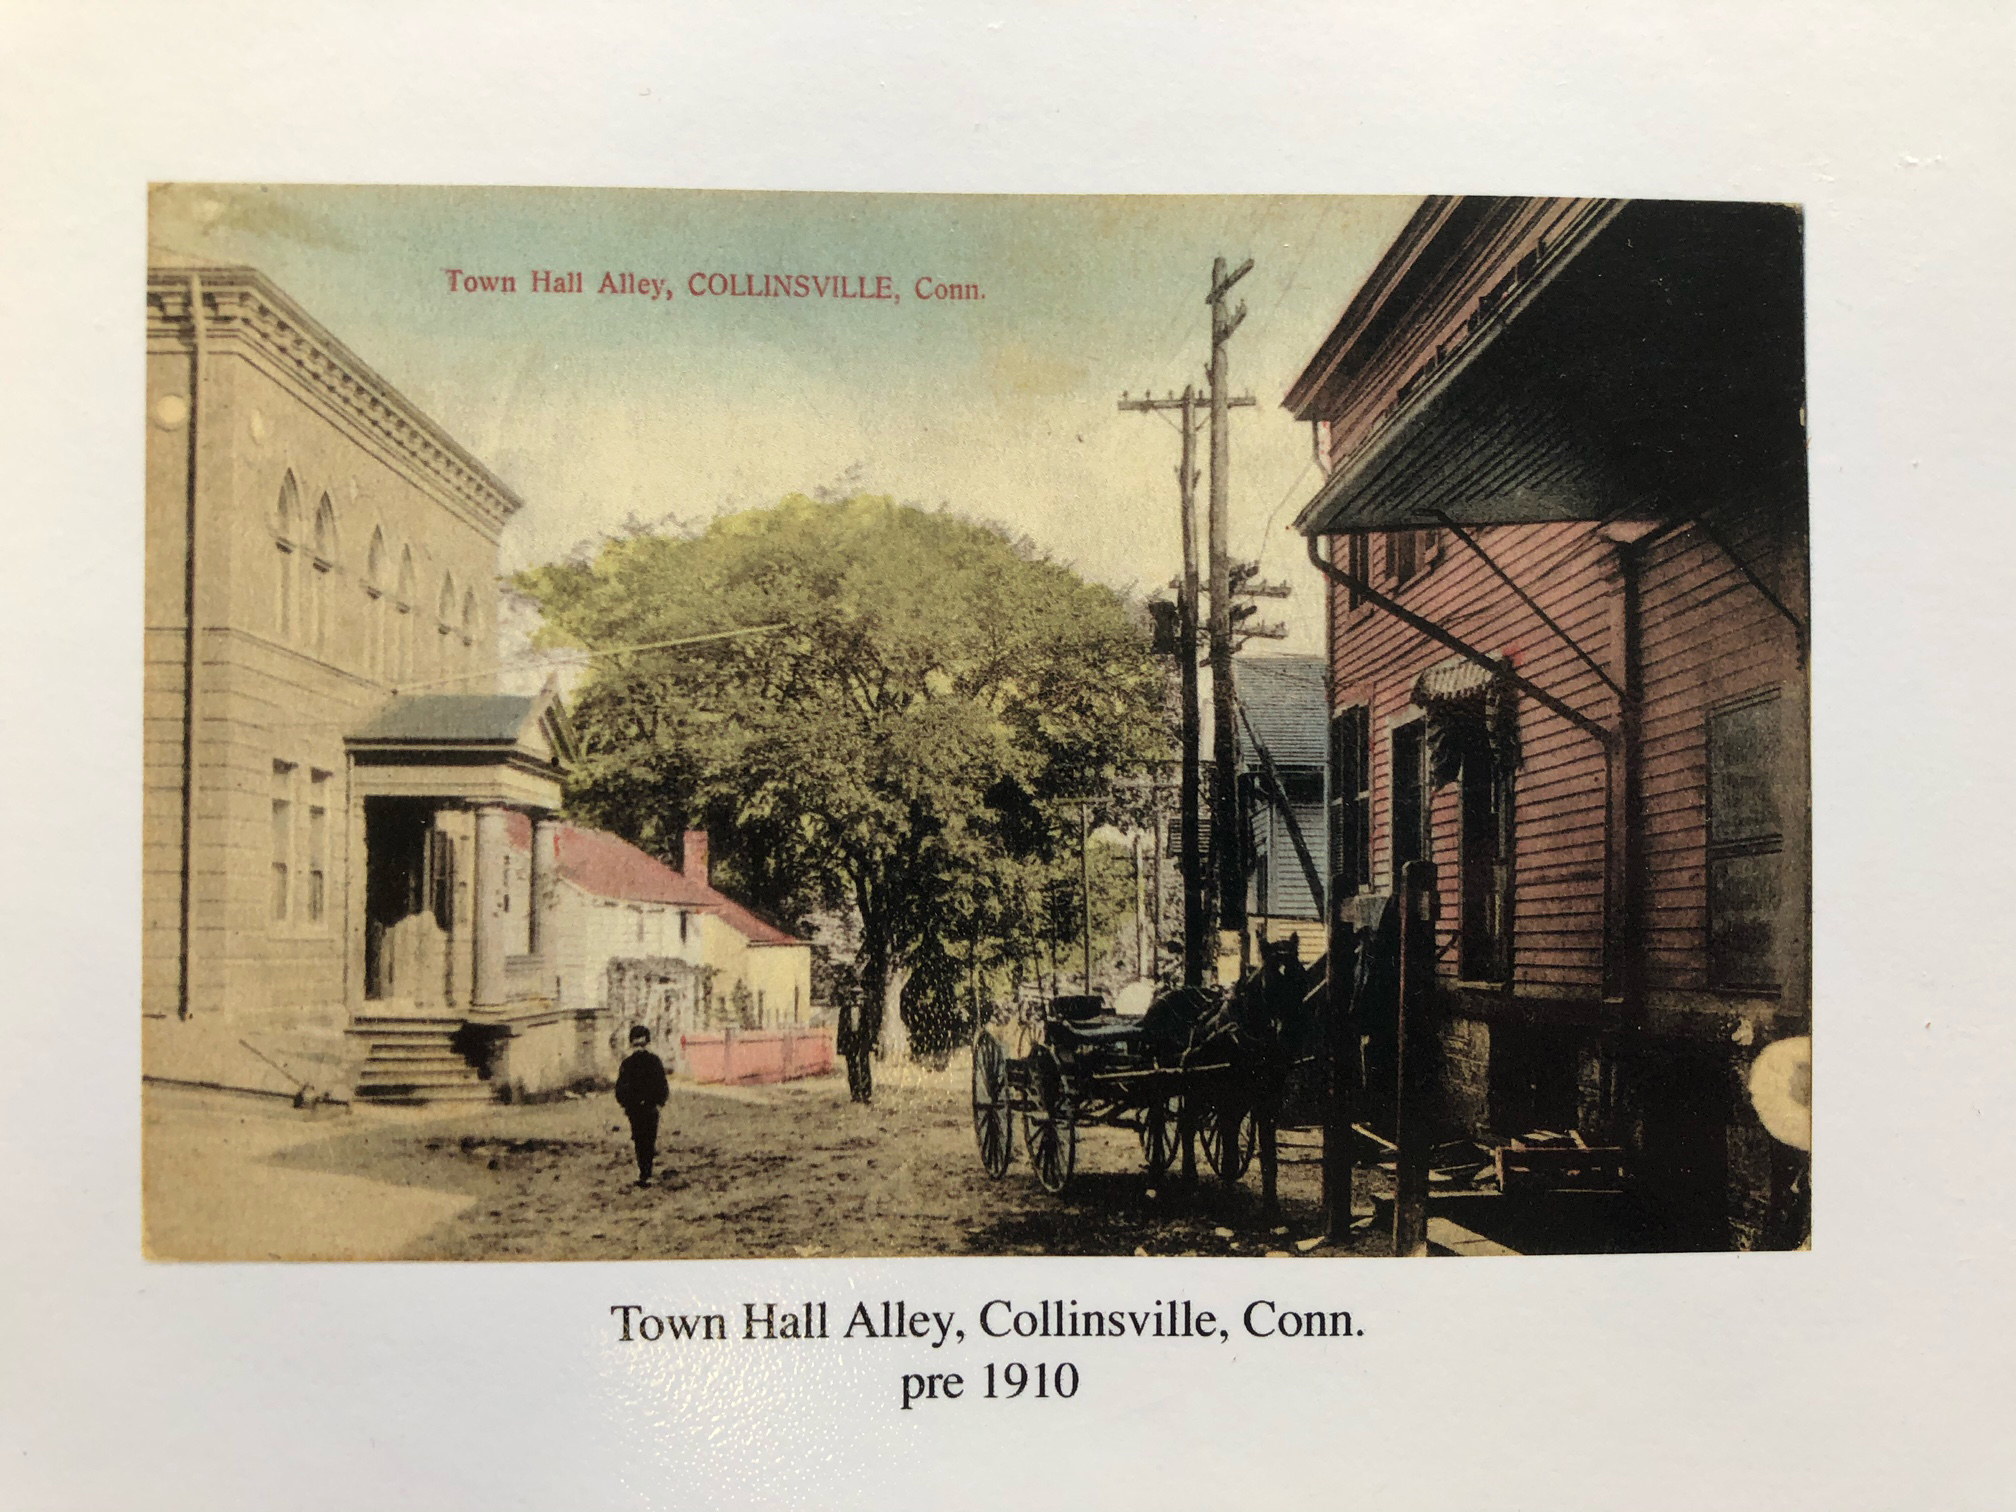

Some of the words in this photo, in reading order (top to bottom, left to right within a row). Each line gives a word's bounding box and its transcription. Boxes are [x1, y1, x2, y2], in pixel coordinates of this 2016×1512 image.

[447, 269, 516, 293] Town
[531, 270, 583, 293] Hall
[598, 272, 674, 301] Alley,
[688, 273, 901, 303] COLLINSVILLE,
[915, 277, 986, 300] Conn.
[609, 1305, 728, 1342] Town
[742, 1301, 830, 1340] Hall
[843, 1300, 966, 1351] Alley,
[979, 1299, 1230, 1346] Collinsville,
[1243, 1300, 1365, 1339] Conn.
[900, 1373, 964, 1410] pre
[984, 1362, 1080, 1400] 1910
